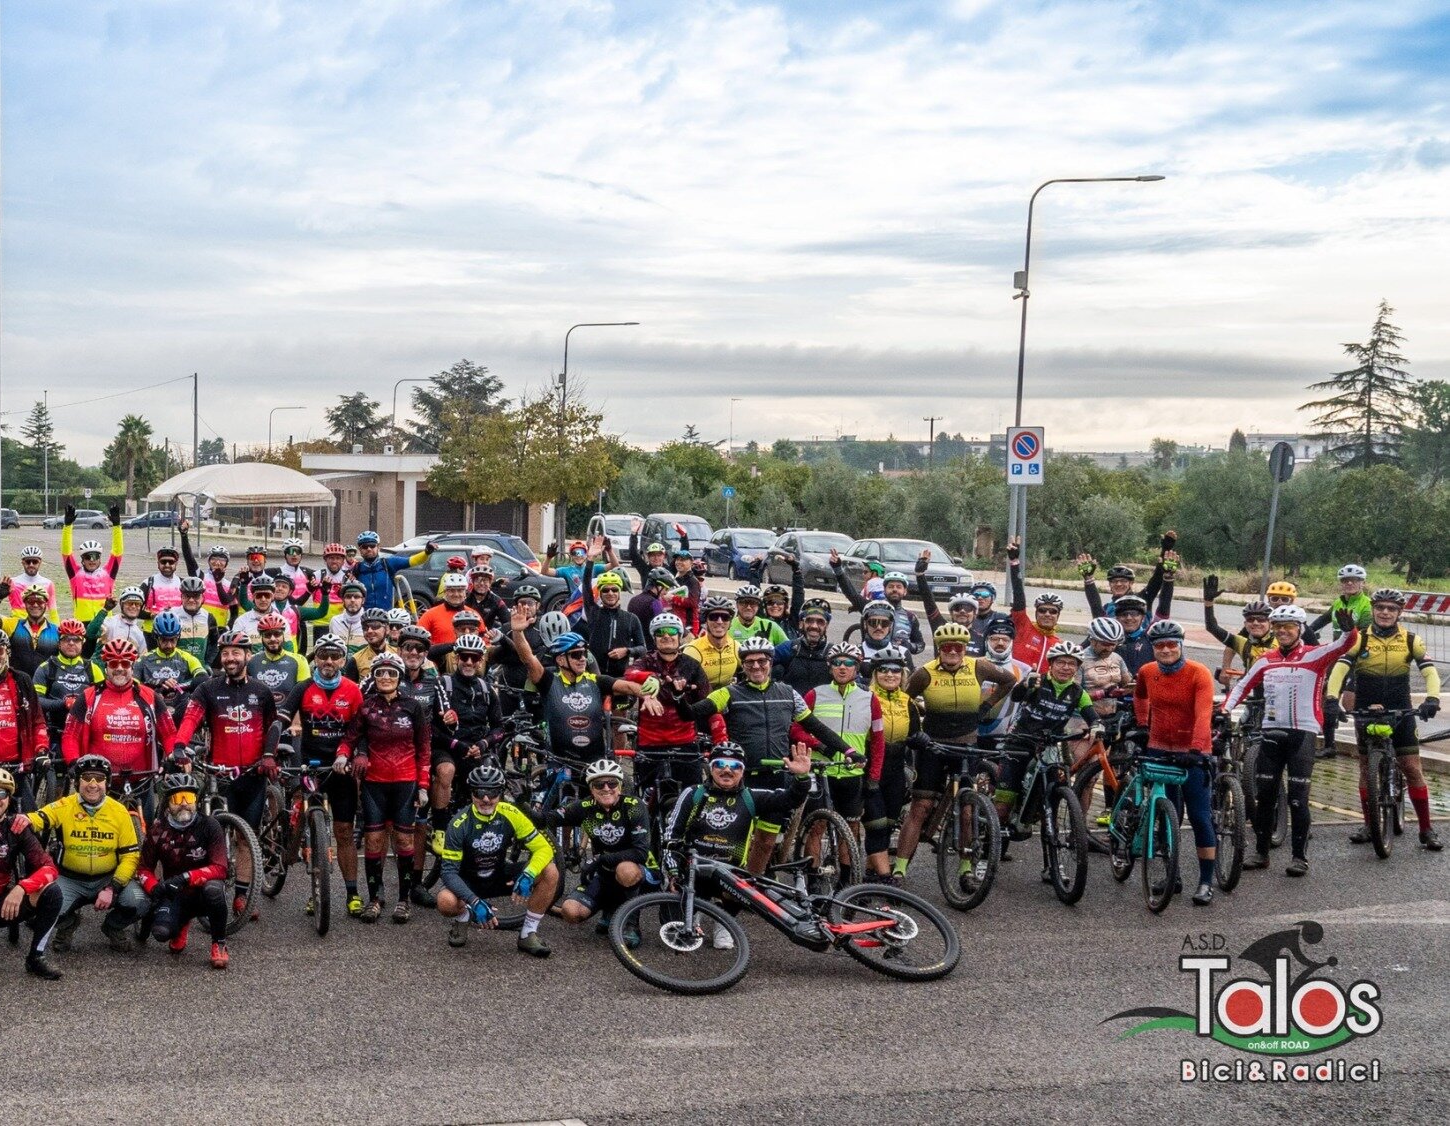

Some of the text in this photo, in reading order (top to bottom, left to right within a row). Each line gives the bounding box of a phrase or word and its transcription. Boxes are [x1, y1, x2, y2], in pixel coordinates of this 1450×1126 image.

[1013, 464, 1021, 474] P
[70, 830, 114, 839] ALL BIKE
